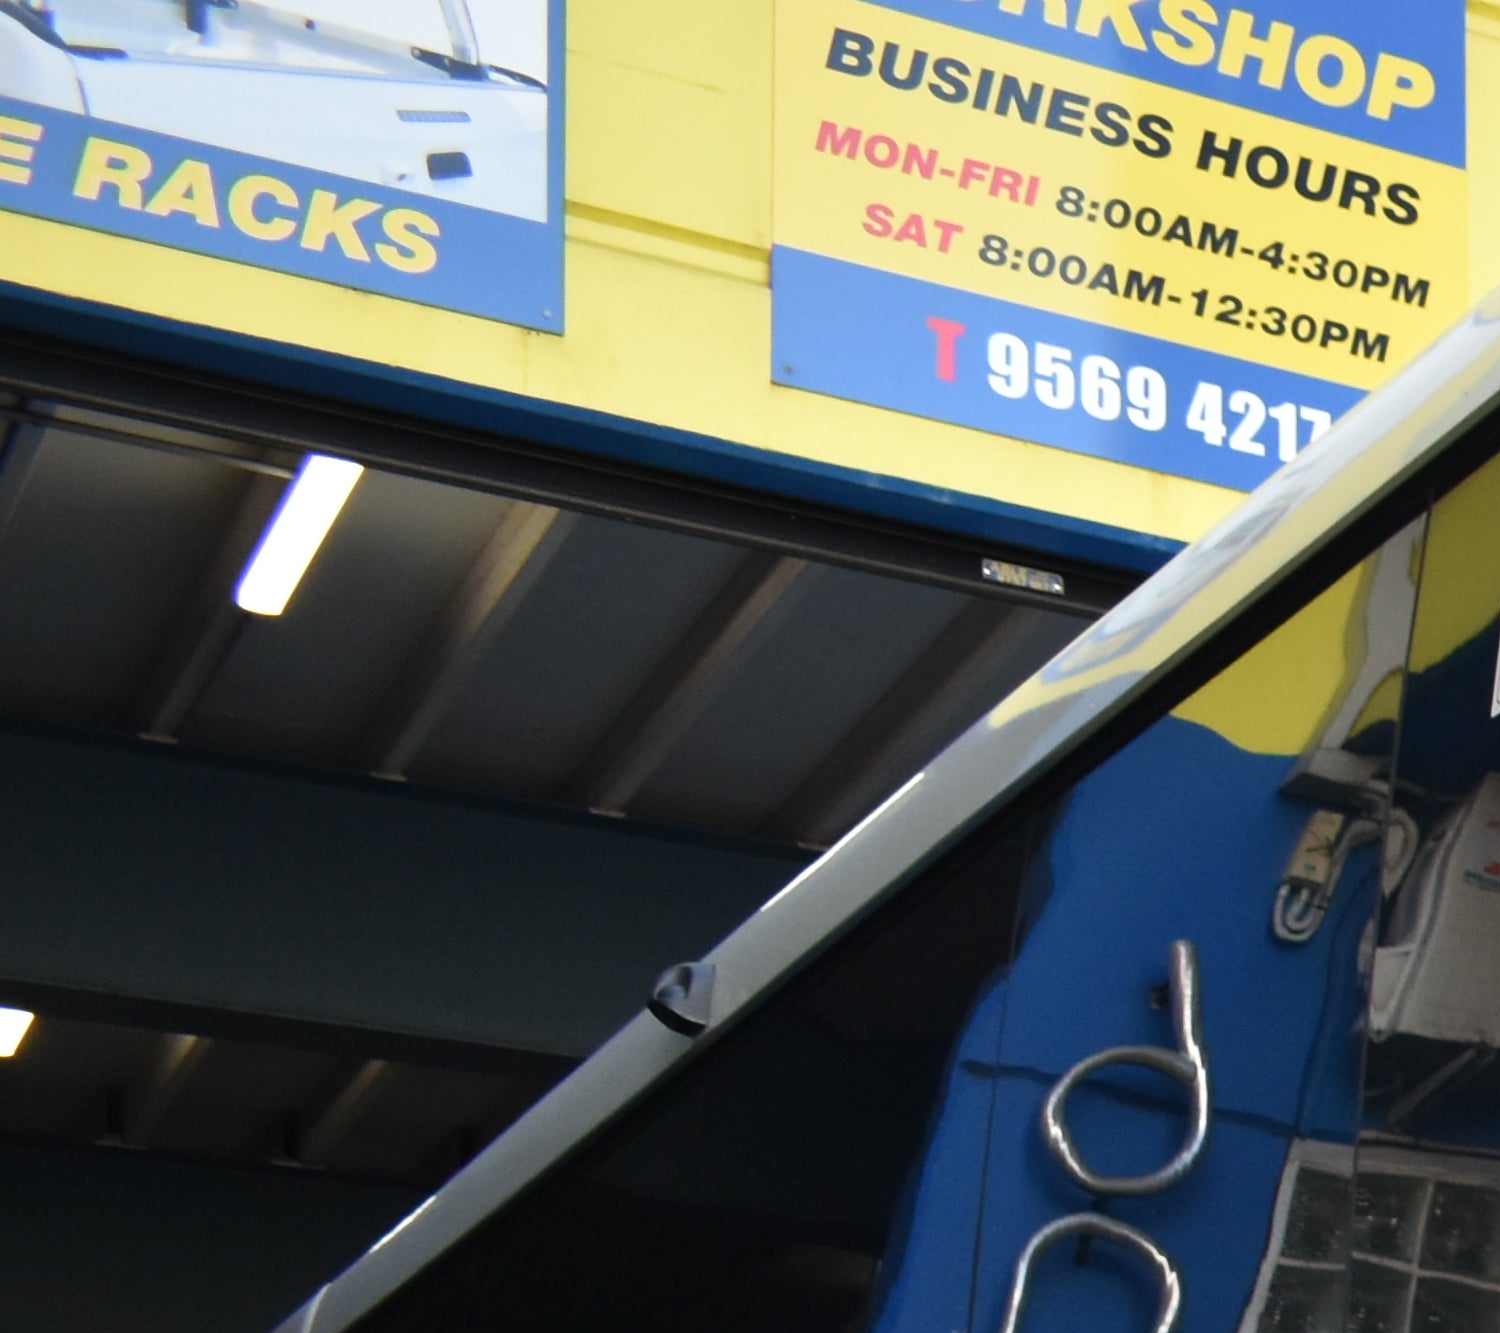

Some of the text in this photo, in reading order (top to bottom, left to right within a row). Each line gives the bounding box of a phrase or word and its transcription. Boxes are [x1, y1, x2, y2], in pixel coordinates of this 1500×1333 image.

[74, 136, 441, 273] RACKS
[826, 27, 1420, 226] BUSINESS HOURS
[814, 120, 1431, 307] MON-FRI 8:00AM-4:30PM
[862, 203, 1390, 363] SAT 8:00AM-12:30PM
[926, 316, 966, 382] T
[986, 332, 1167, 431] 9569
